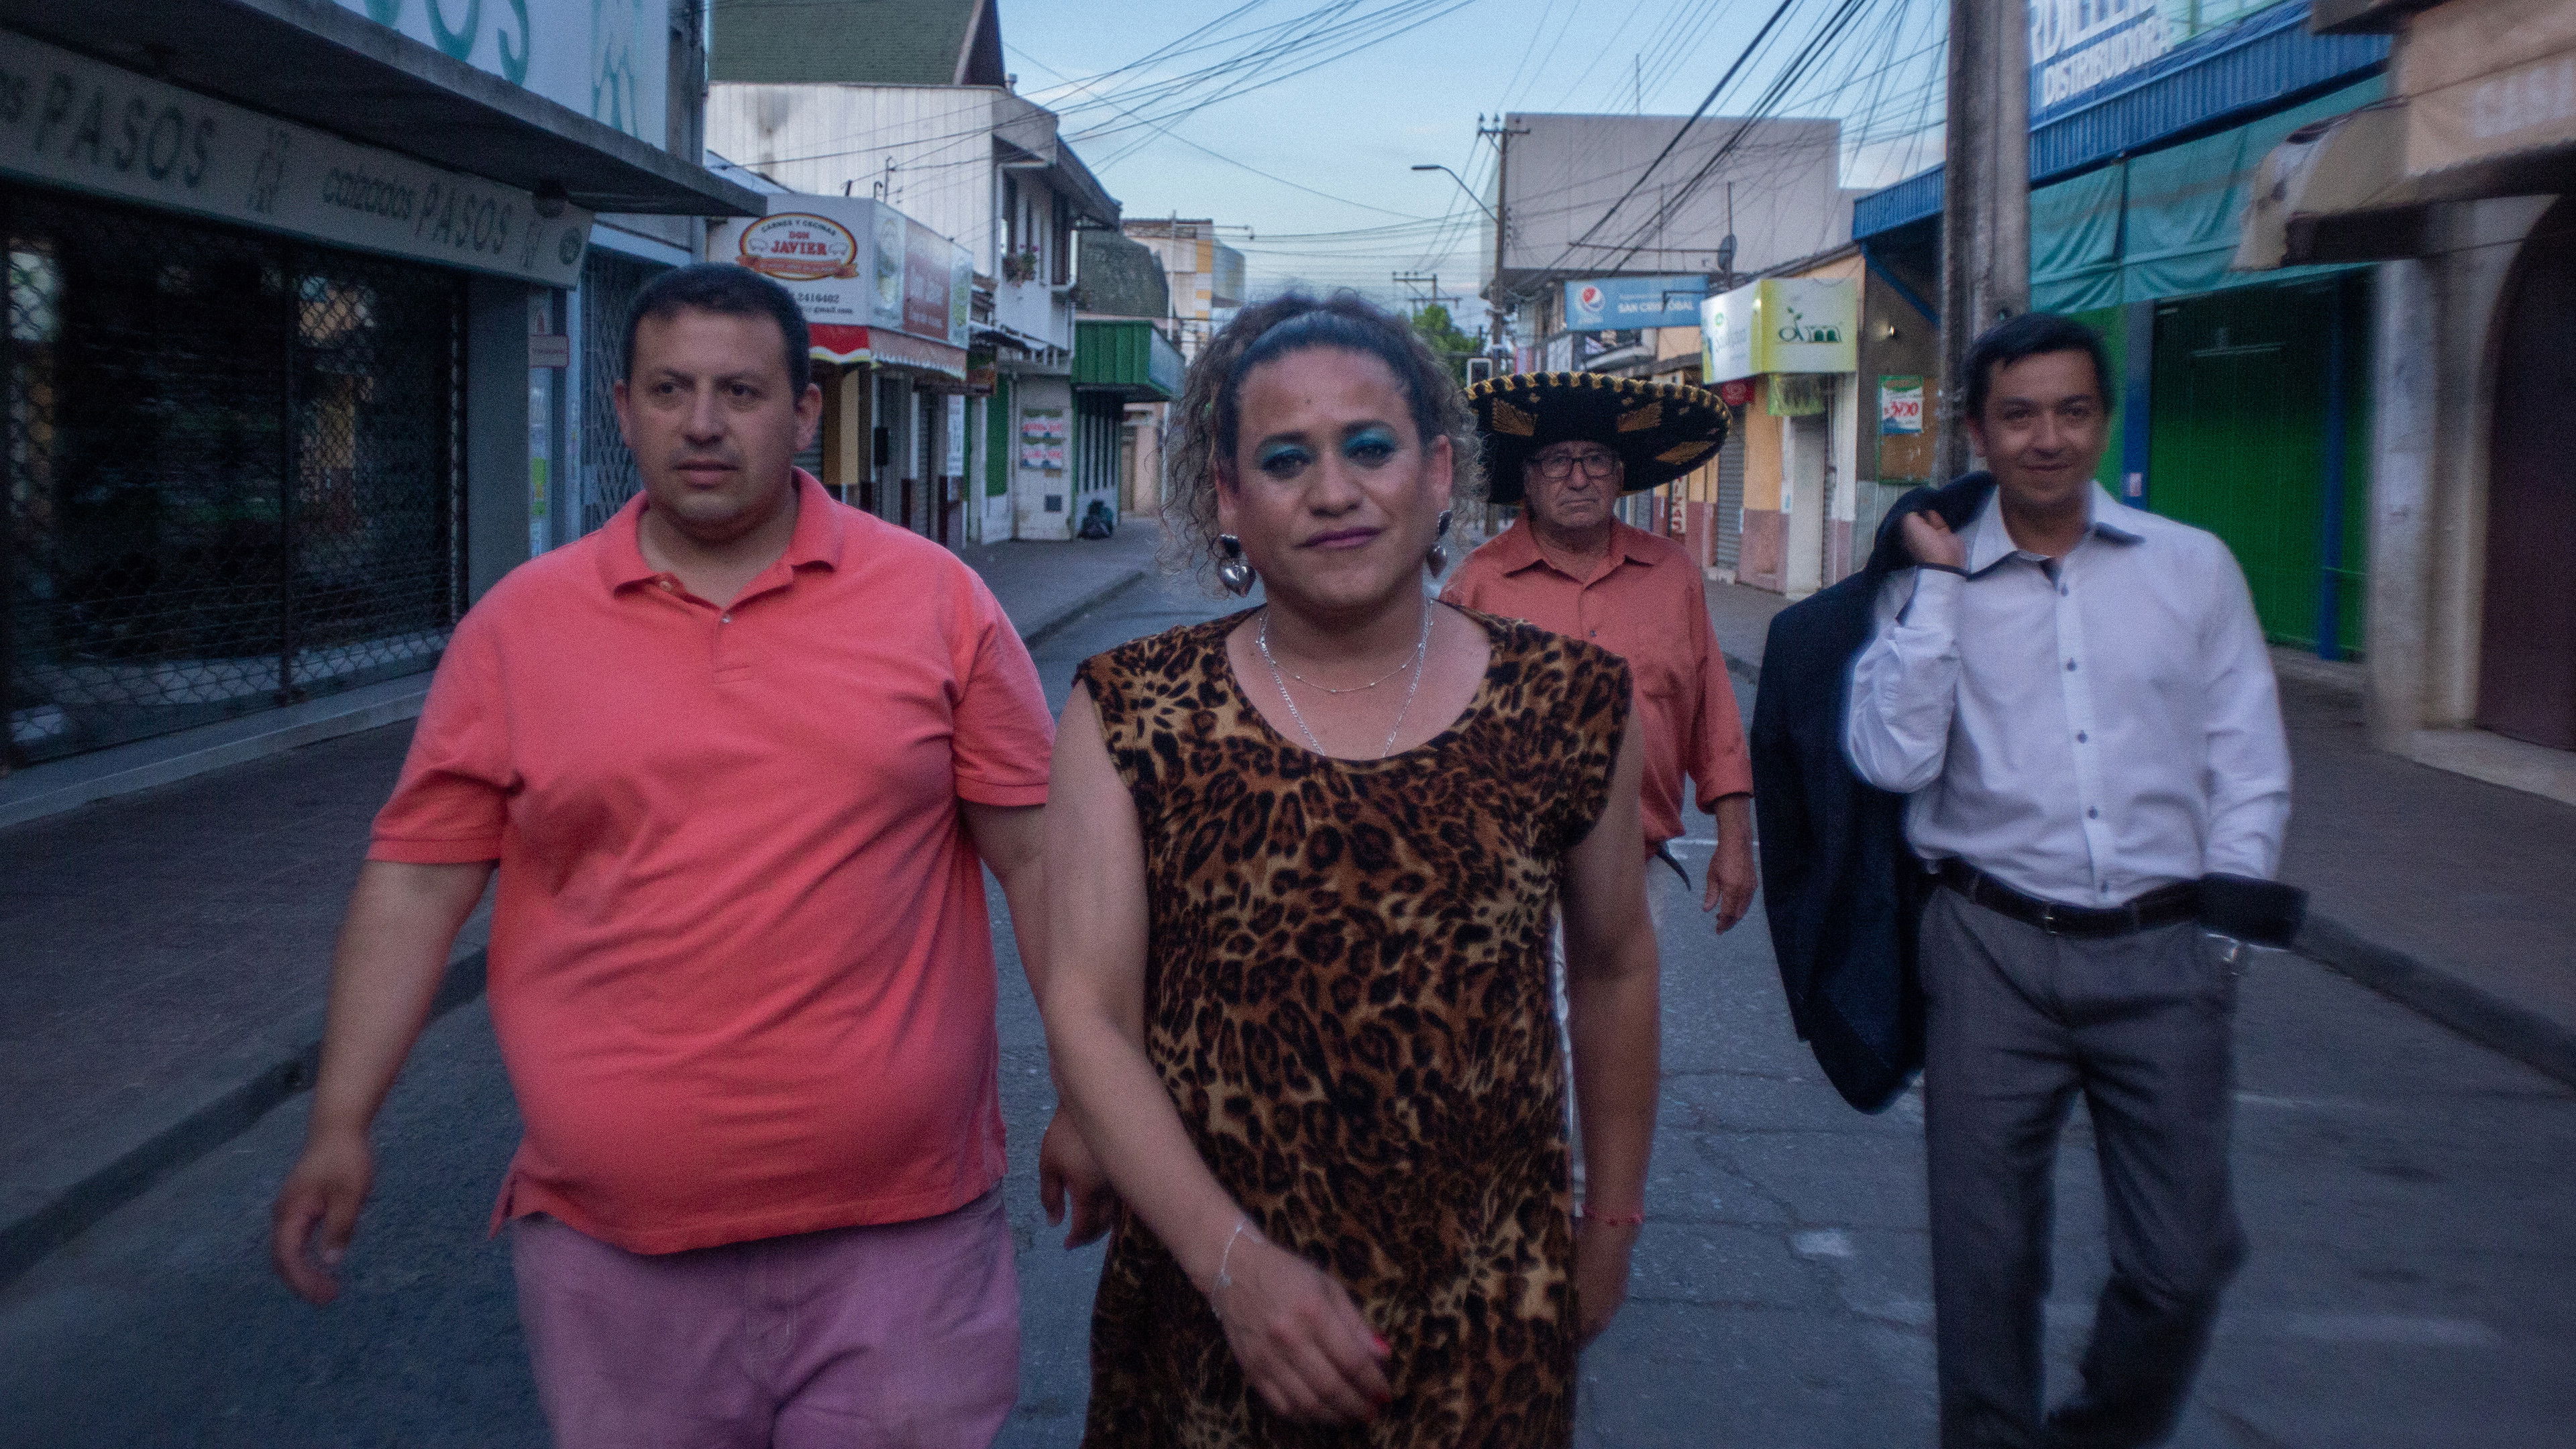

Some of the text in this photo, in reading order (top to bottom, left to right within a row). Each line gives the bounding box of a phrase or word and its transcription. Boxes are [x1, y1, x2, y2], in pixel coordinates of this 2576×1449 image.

[2041, 13, 2176, 107] DISTRIBUIDORA
[34, 71, 217, 188] PASOS
[414, 182, 514, 255] PASOS
[761, 219, 792, 233] CARNES
[802, 220, 837, 236] CECINAS
[788, 231, 810, 239] DON
[771, 240, 827, 256] JAVIER
